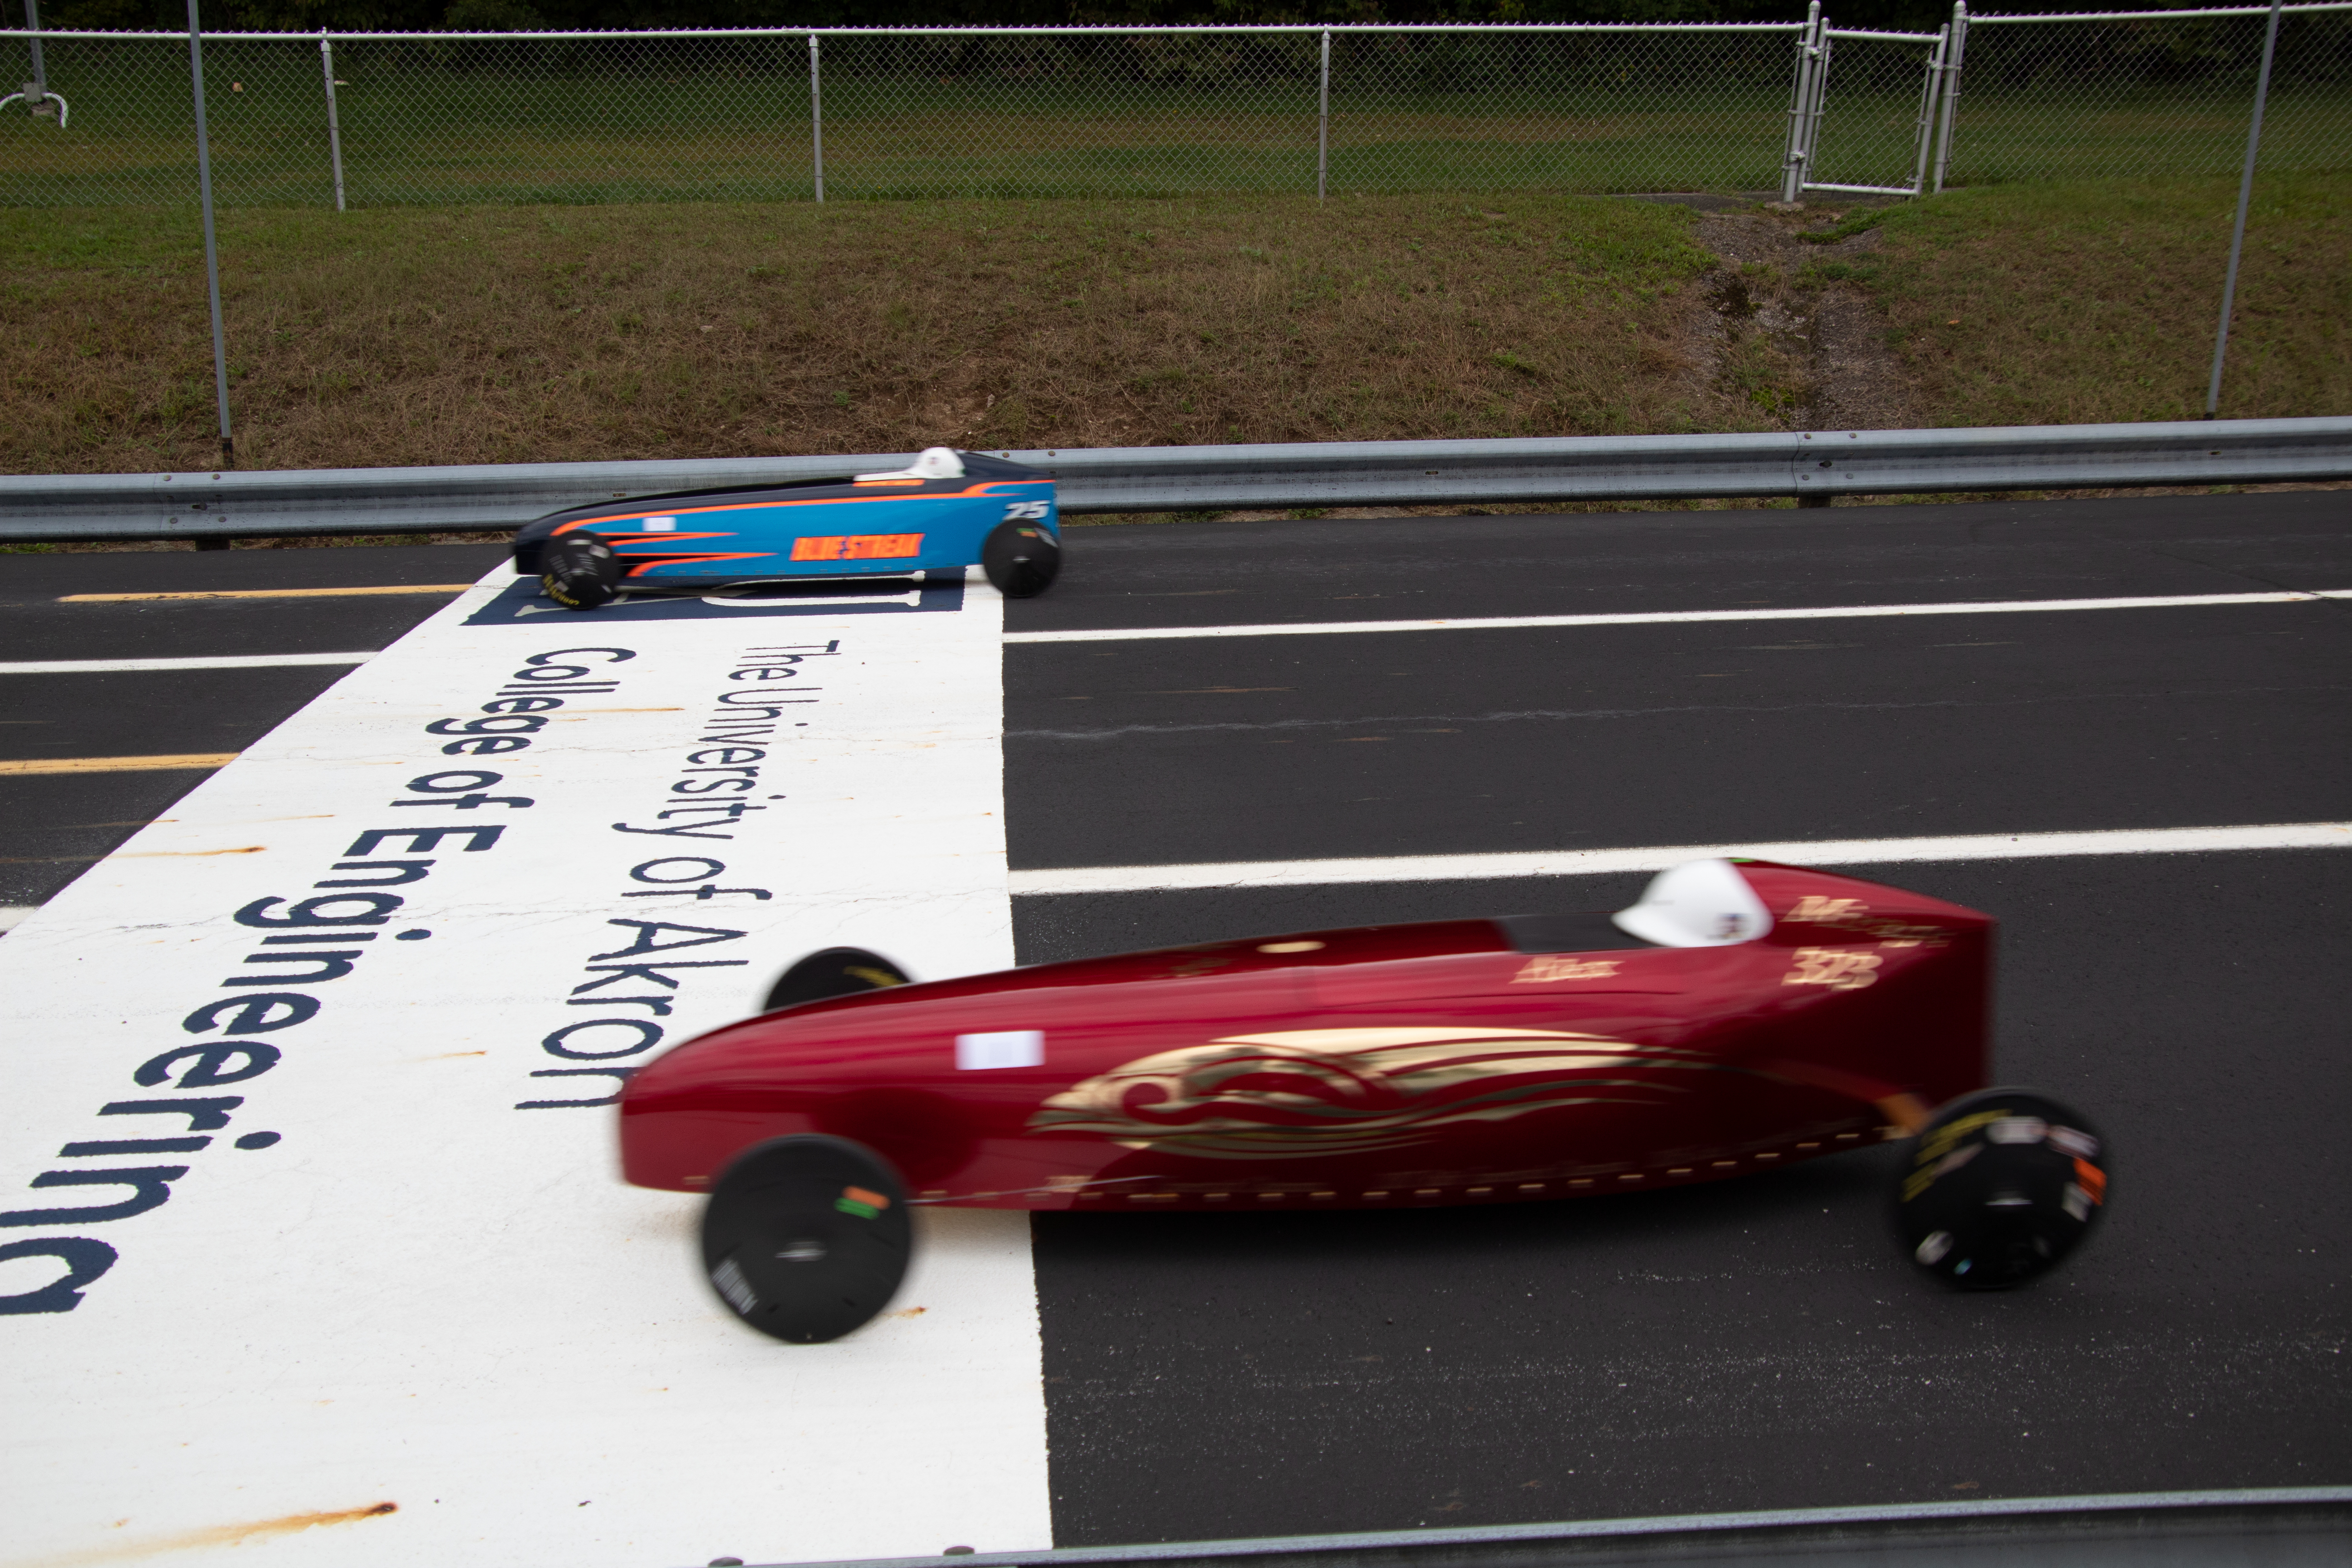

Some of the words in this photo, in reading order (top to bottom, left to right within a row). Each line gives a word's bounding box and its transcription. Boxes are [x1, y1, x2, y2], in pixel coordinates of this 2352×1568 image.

[1002, 499, 1052, 521] 25
[729, 640, 841, 680] The
[426, 648, 636, 755] College
[612, 688, 822, 839] University
[391, 771, 534, 809] of
[622, 857, 772, 900] of
[514, 919, 749, 1110] Akron
